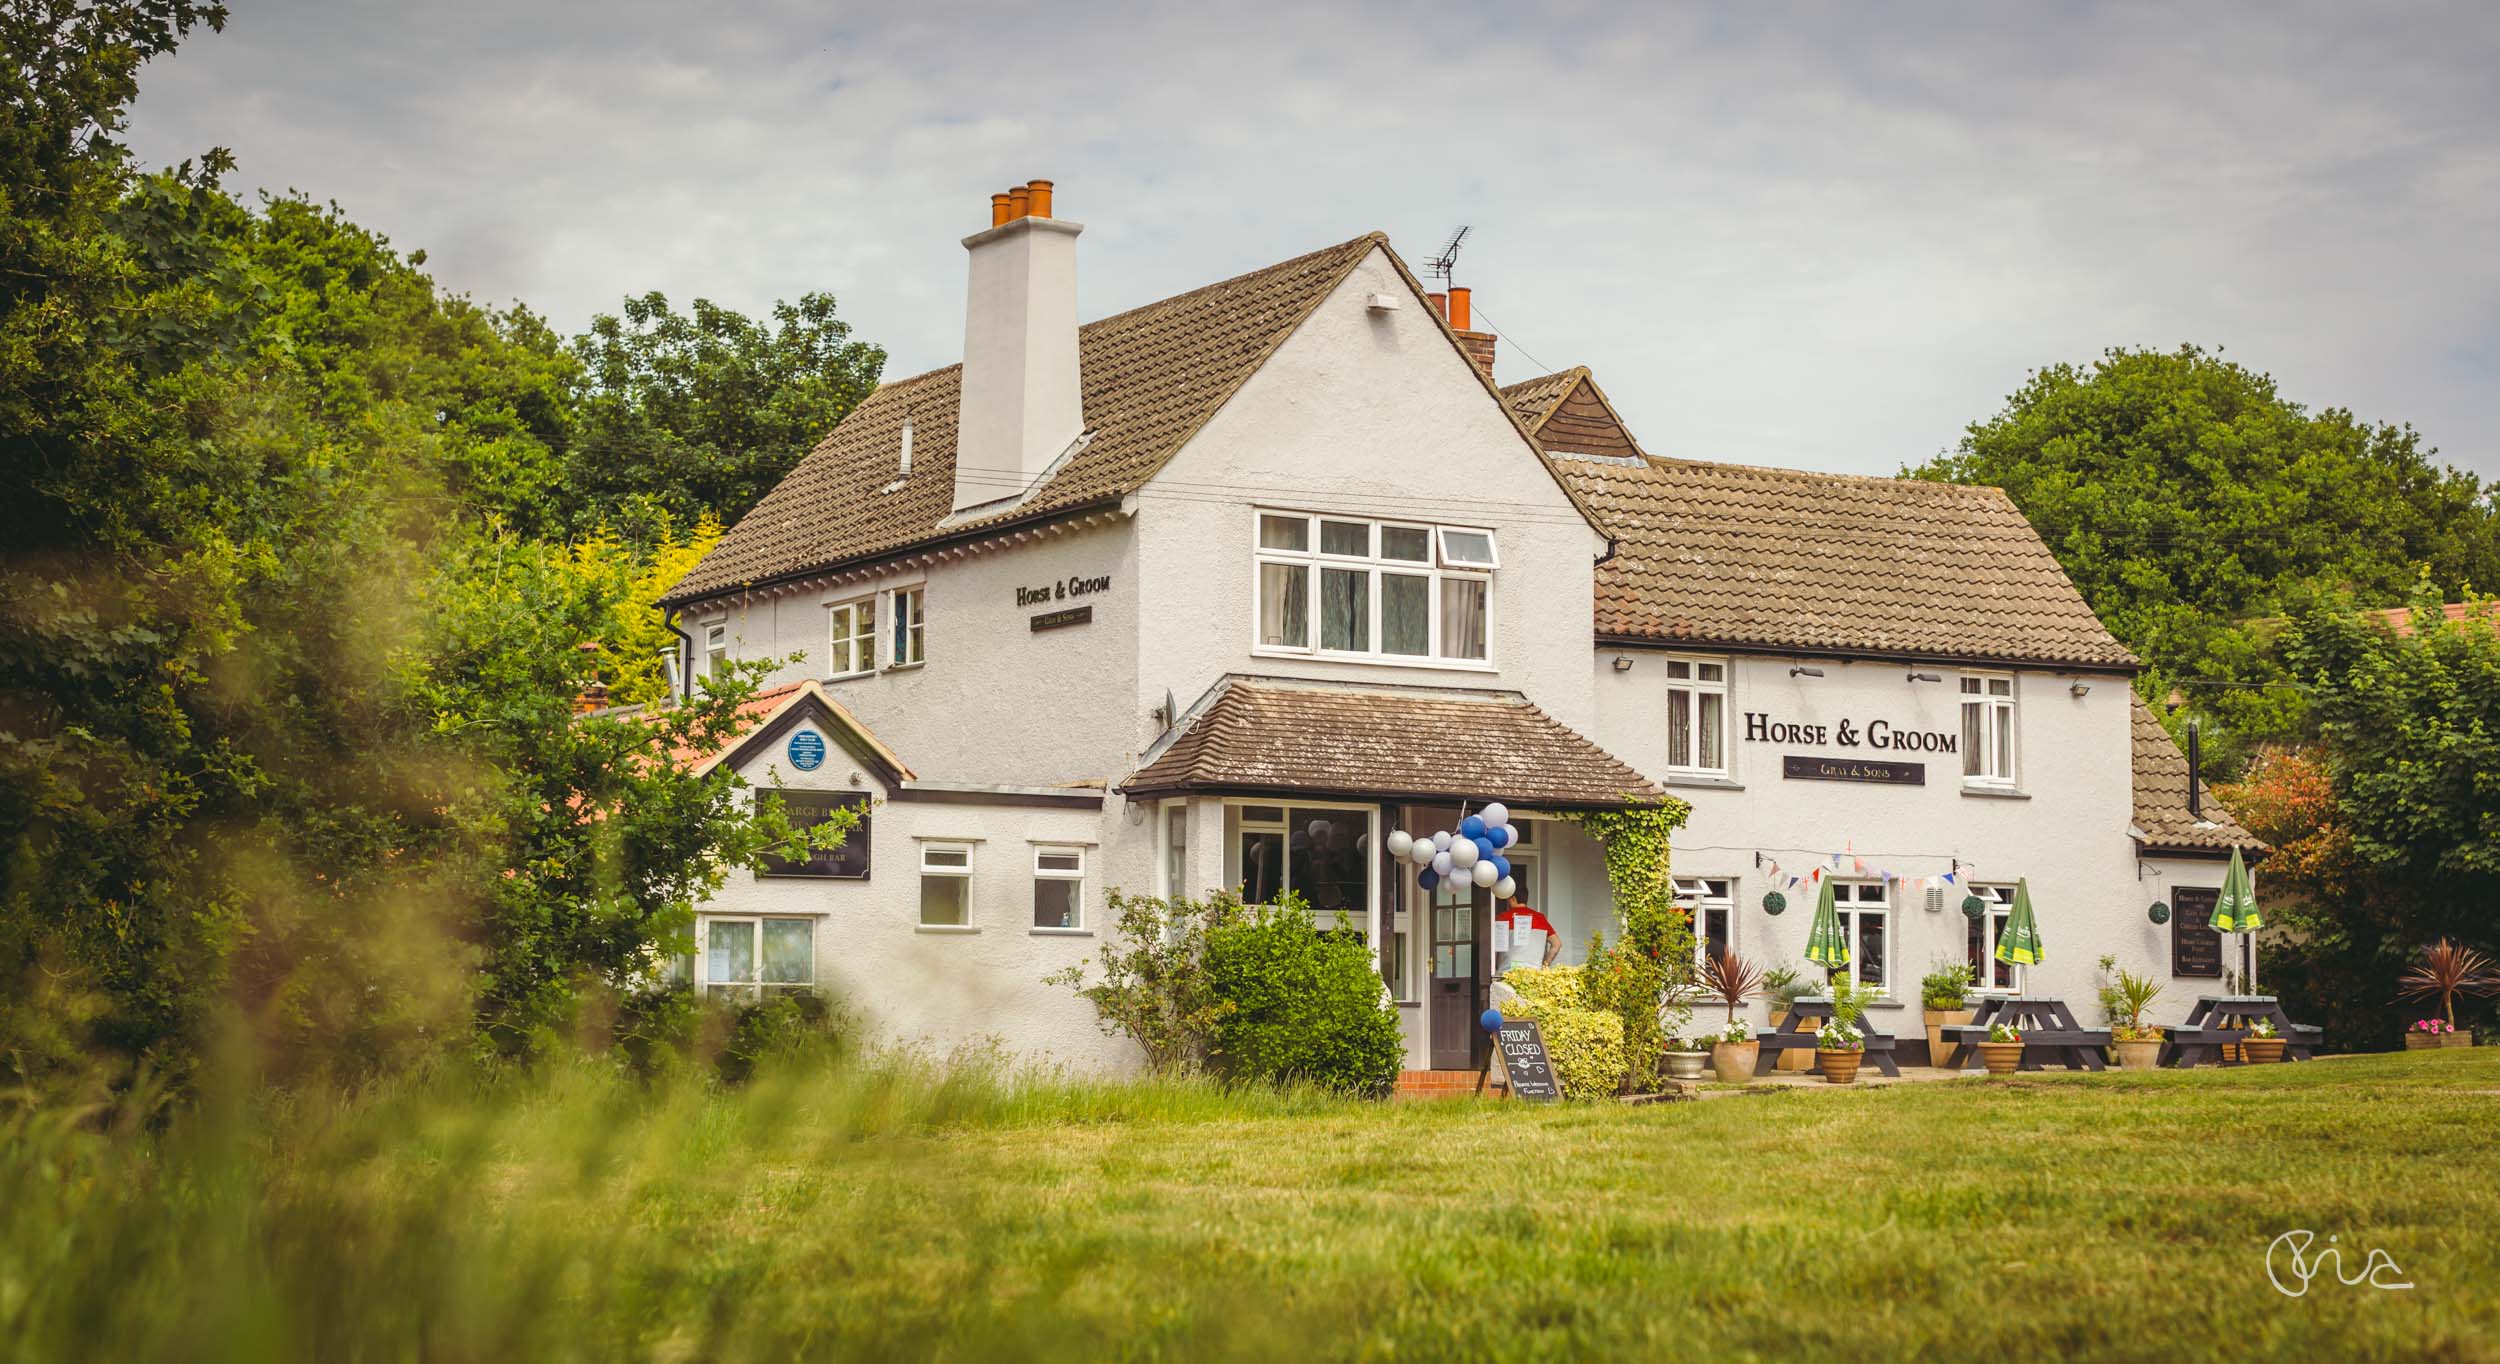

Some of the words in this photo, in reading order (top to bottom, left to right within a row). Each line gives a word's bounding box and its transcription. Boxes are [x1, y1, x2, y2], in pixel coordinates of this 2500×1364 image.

[1016, 587, 1051, 607] HORSE
[1055, 580, 1065, 599] &
[1069, 576, 1110, 596] GROOM
[1744, 712, 1827, 746] HORSE
[1836, 718, 1860, 747] &
[1867, 719, 1957, 753] GROOM
[1851, 765, 1861, 777] &
[1863, 766, 1890, 778] SONS
[1500, 1030, 1530, 1041] FRIDAY
[1505, 1043, 1541, 1055] CLOSED
